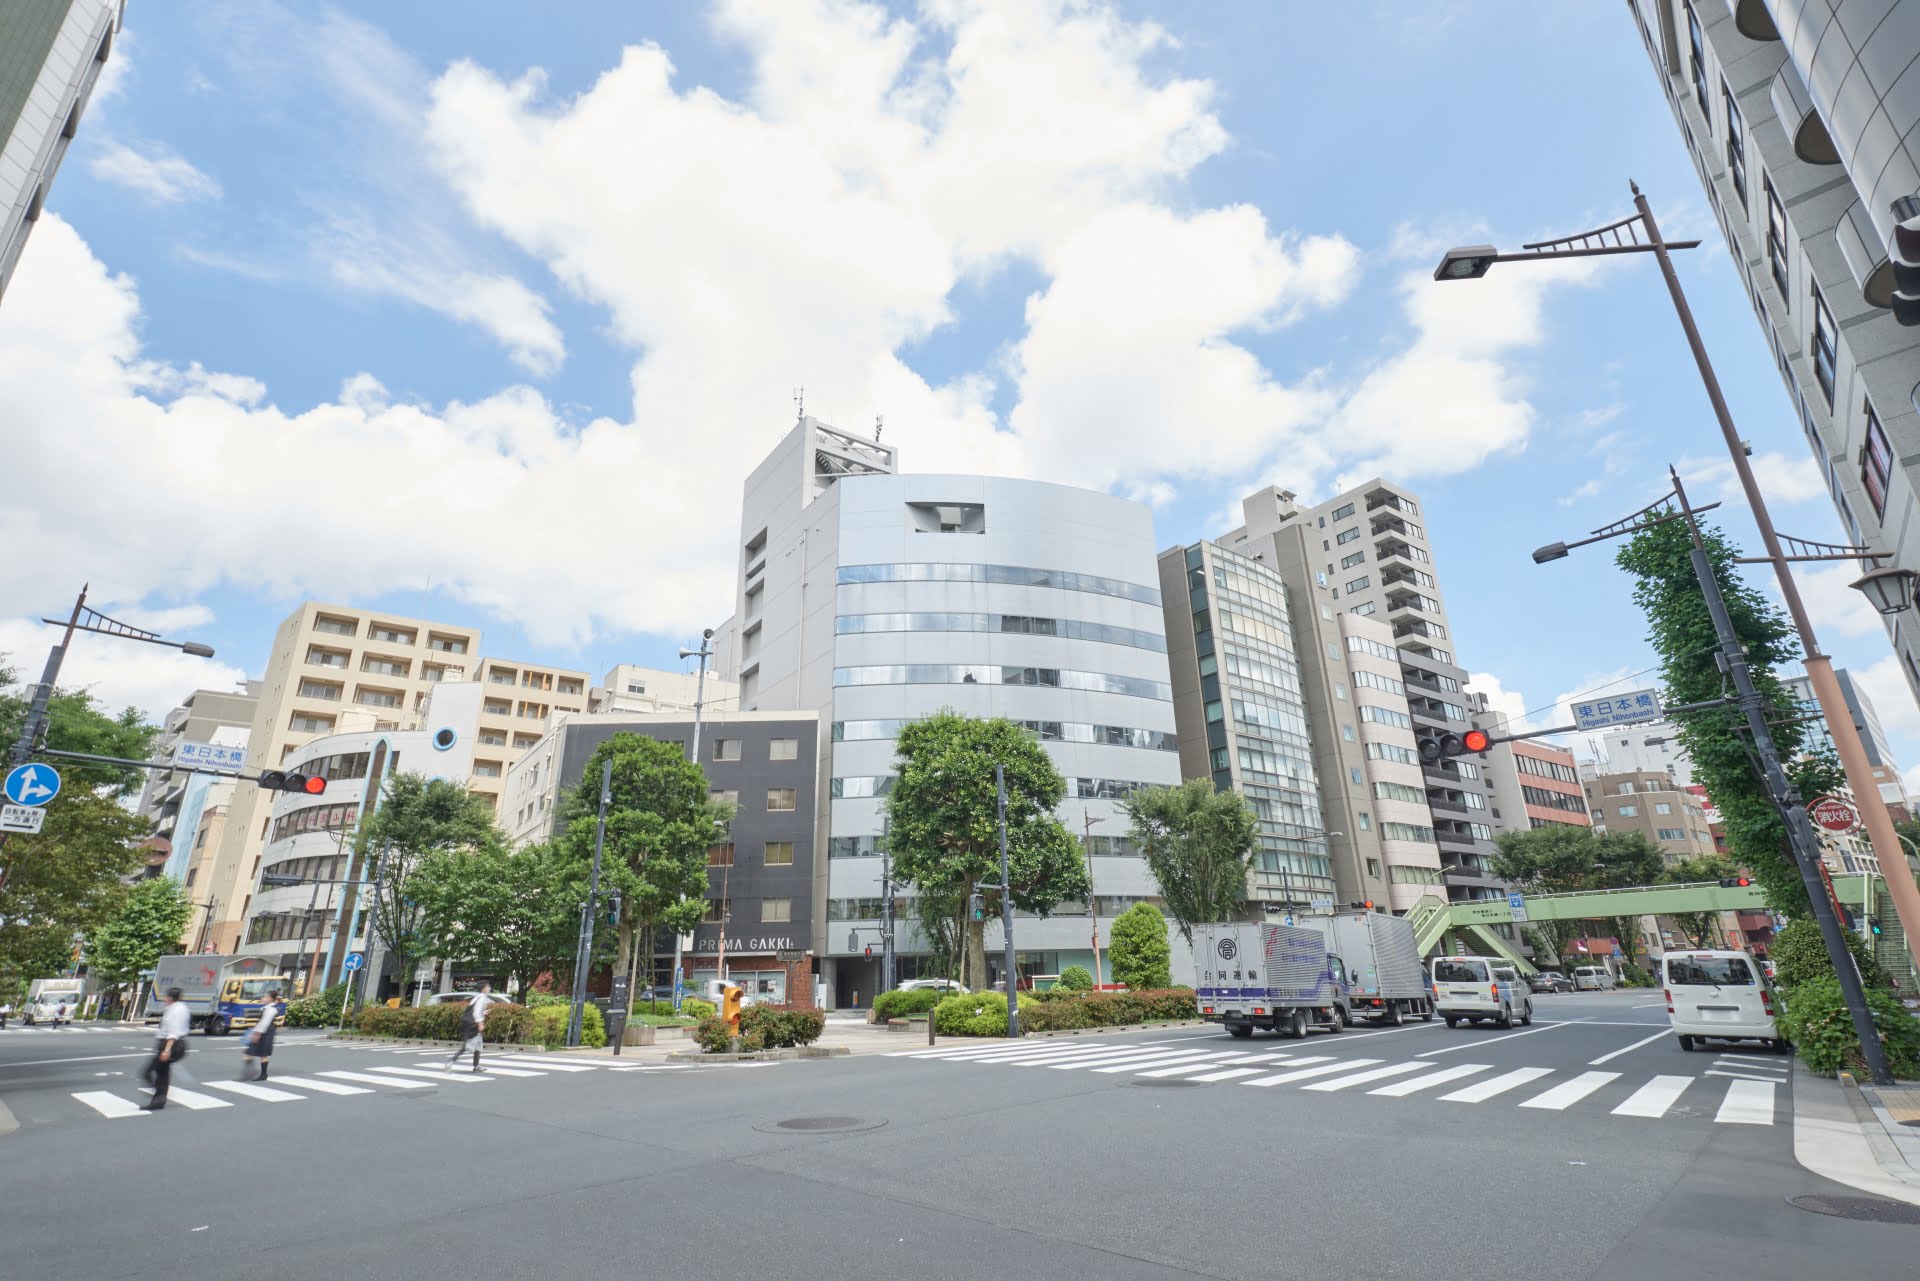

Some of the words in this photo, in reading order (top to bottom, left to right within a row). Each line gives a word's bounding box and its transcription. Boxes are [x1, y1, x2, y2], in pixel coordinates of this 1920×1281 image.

[1577, 693, 1653, 719] 東日本橋
[1582, 717, 1610, 727] Higashi
[1612, 708, 1655, 721] Nihonbashi
[181, 743, 243, 762] 東日本橋
[177, 755, 203, 765] Higashi
[204, 759, 242, 769] Nihonbashi
[3, 815, 39, 825] 一方通行
[1818, 809, 1853, 823] 消火栓
[698, 938, 743, 951] PRIMA
[749, 937, 790, 950] GAKKI
